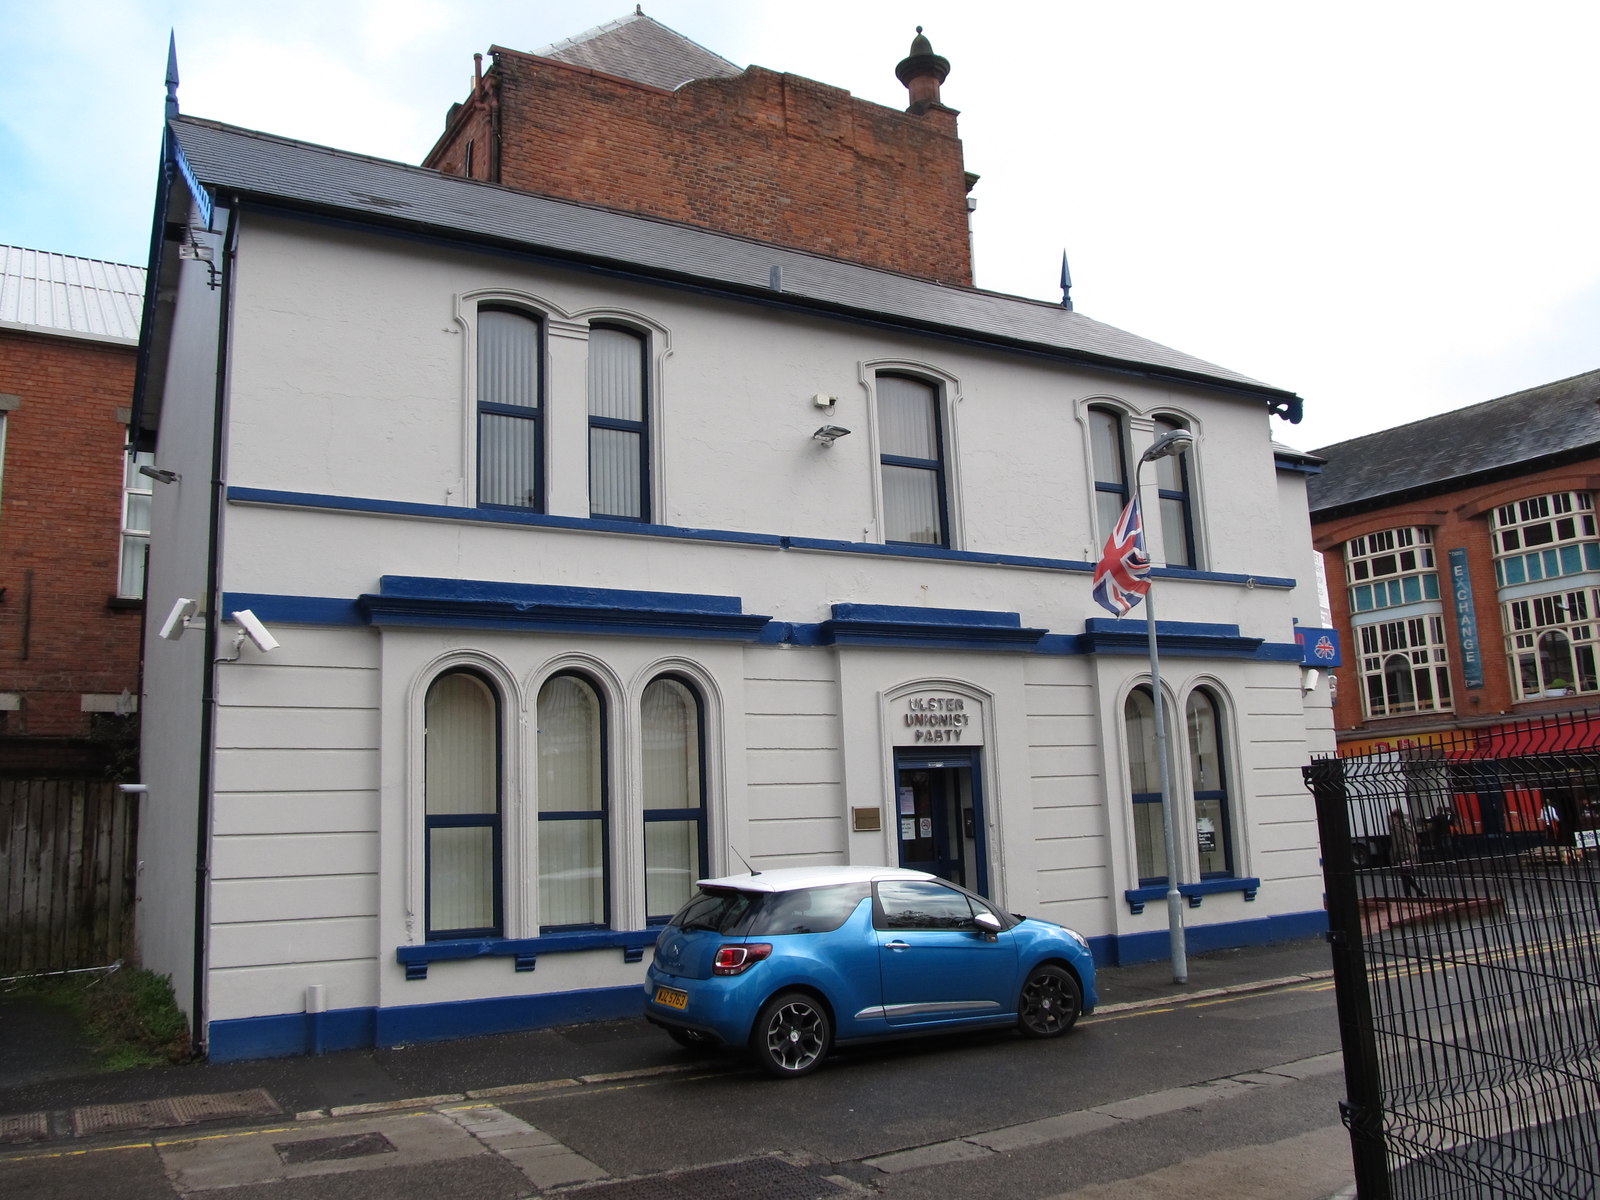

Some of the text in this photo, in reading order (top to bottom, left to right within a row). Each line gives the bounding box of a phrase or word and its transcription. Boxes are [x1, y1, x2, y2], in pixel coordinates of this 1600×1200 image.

[1453, 565, 1476, 662] EXCHANGE
[909, 697, 964, 711] ULSTER
[904, 713, 969, 727] UNIONIST
[914, 729, 962, 743] PARTY
